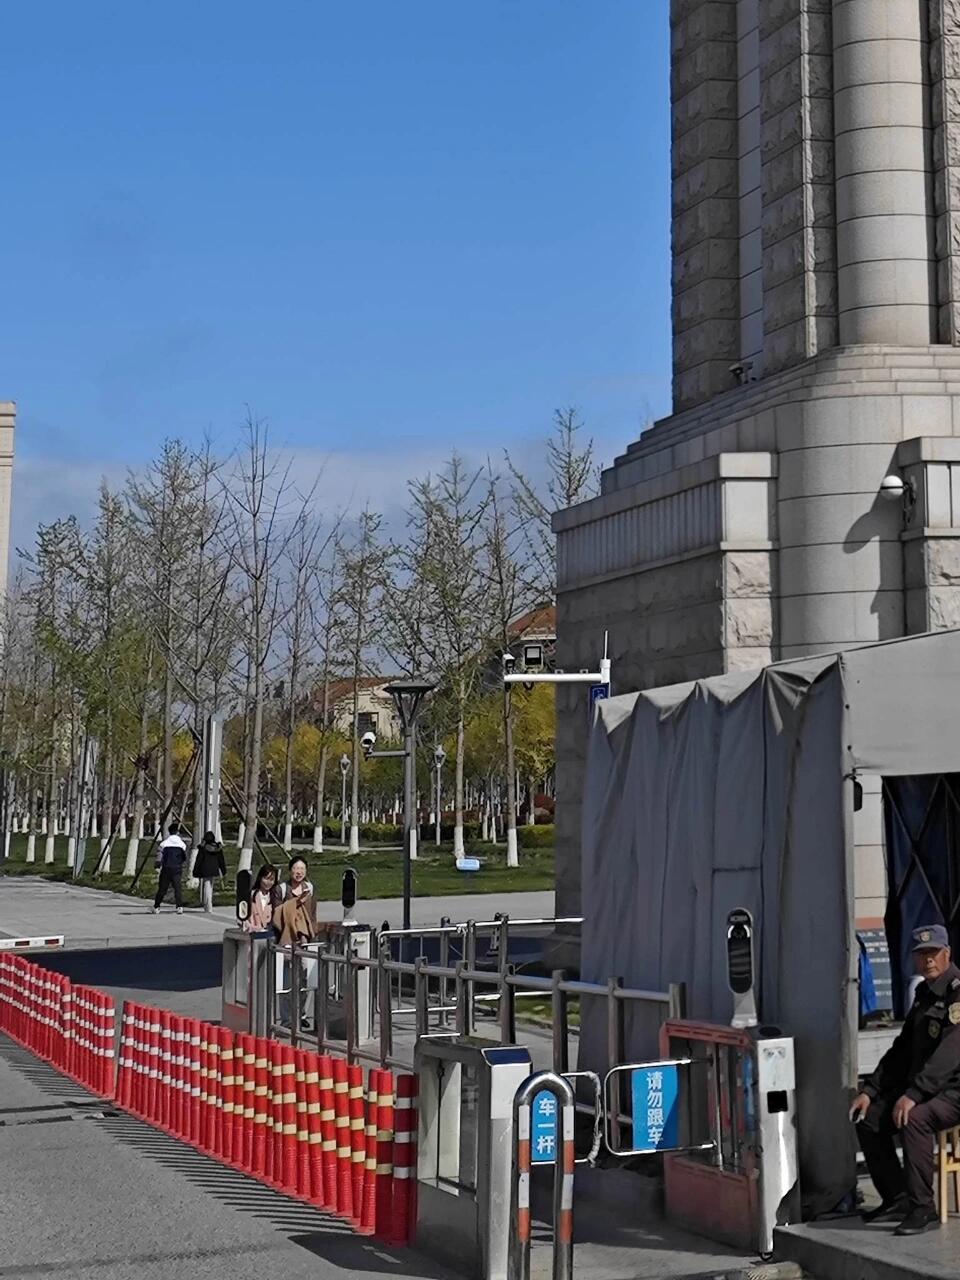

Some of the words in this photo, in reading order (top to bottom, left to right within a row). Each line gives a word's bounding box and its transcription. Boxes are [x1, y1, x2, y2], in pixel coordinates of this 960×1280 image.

[537, 1097, 556, 1155] 车一杆
[646, 1071, 665, 1146] 请勿跟车
